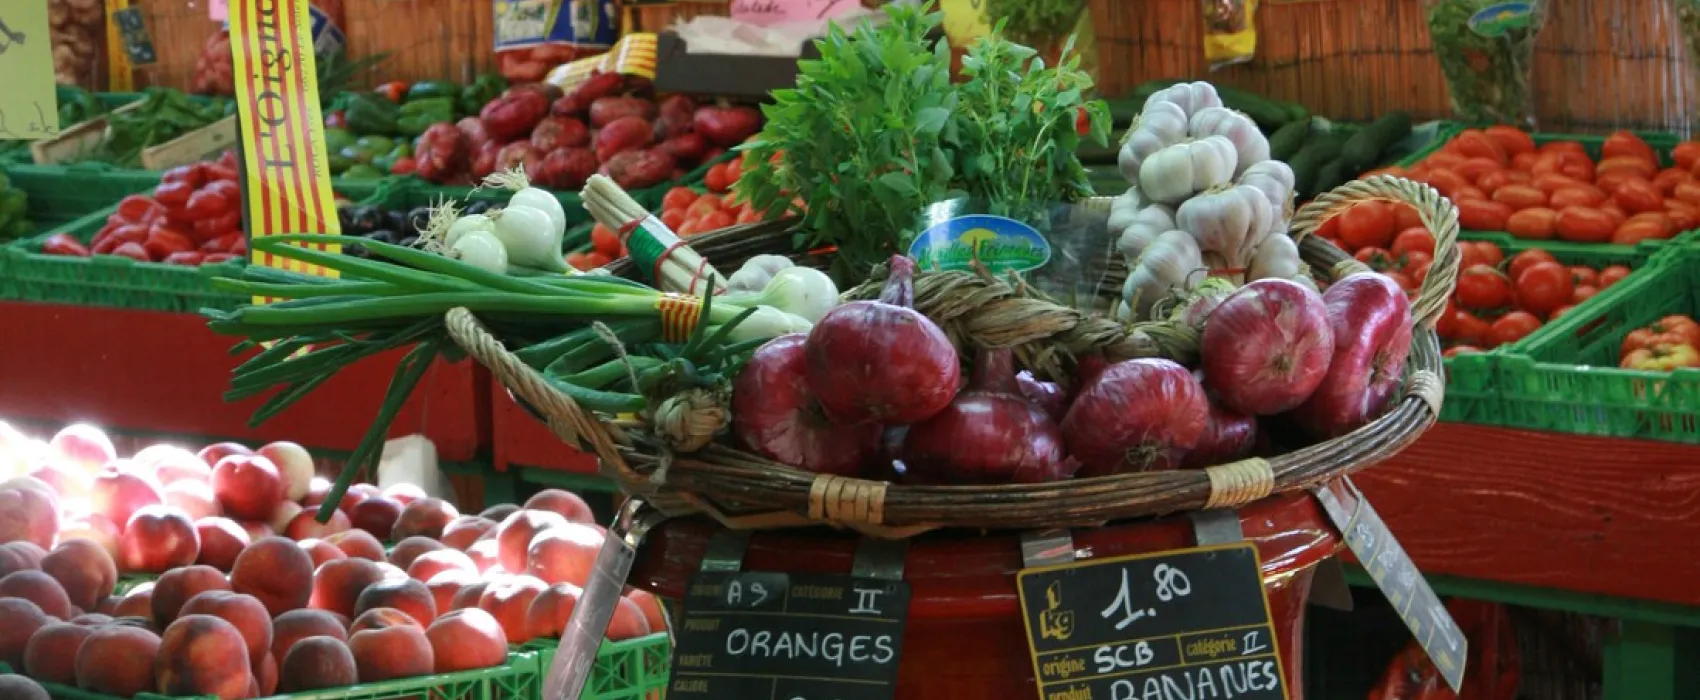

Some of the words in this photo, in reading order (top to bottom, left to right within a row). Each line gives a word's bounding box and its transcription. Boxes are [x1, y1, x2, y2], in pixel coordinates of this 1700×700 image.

[848, 587, 884, 614] II
[1101, 562, 1192, 630] 1.80
[1040, 608, 1075, 640] kg
[726, 628, 894, 667] ORANGES
[1043, 654, 1086, 678] origine
[1094, 641, 1154, 673] SCB
[1186, 634, 1237, 657] catégorie
